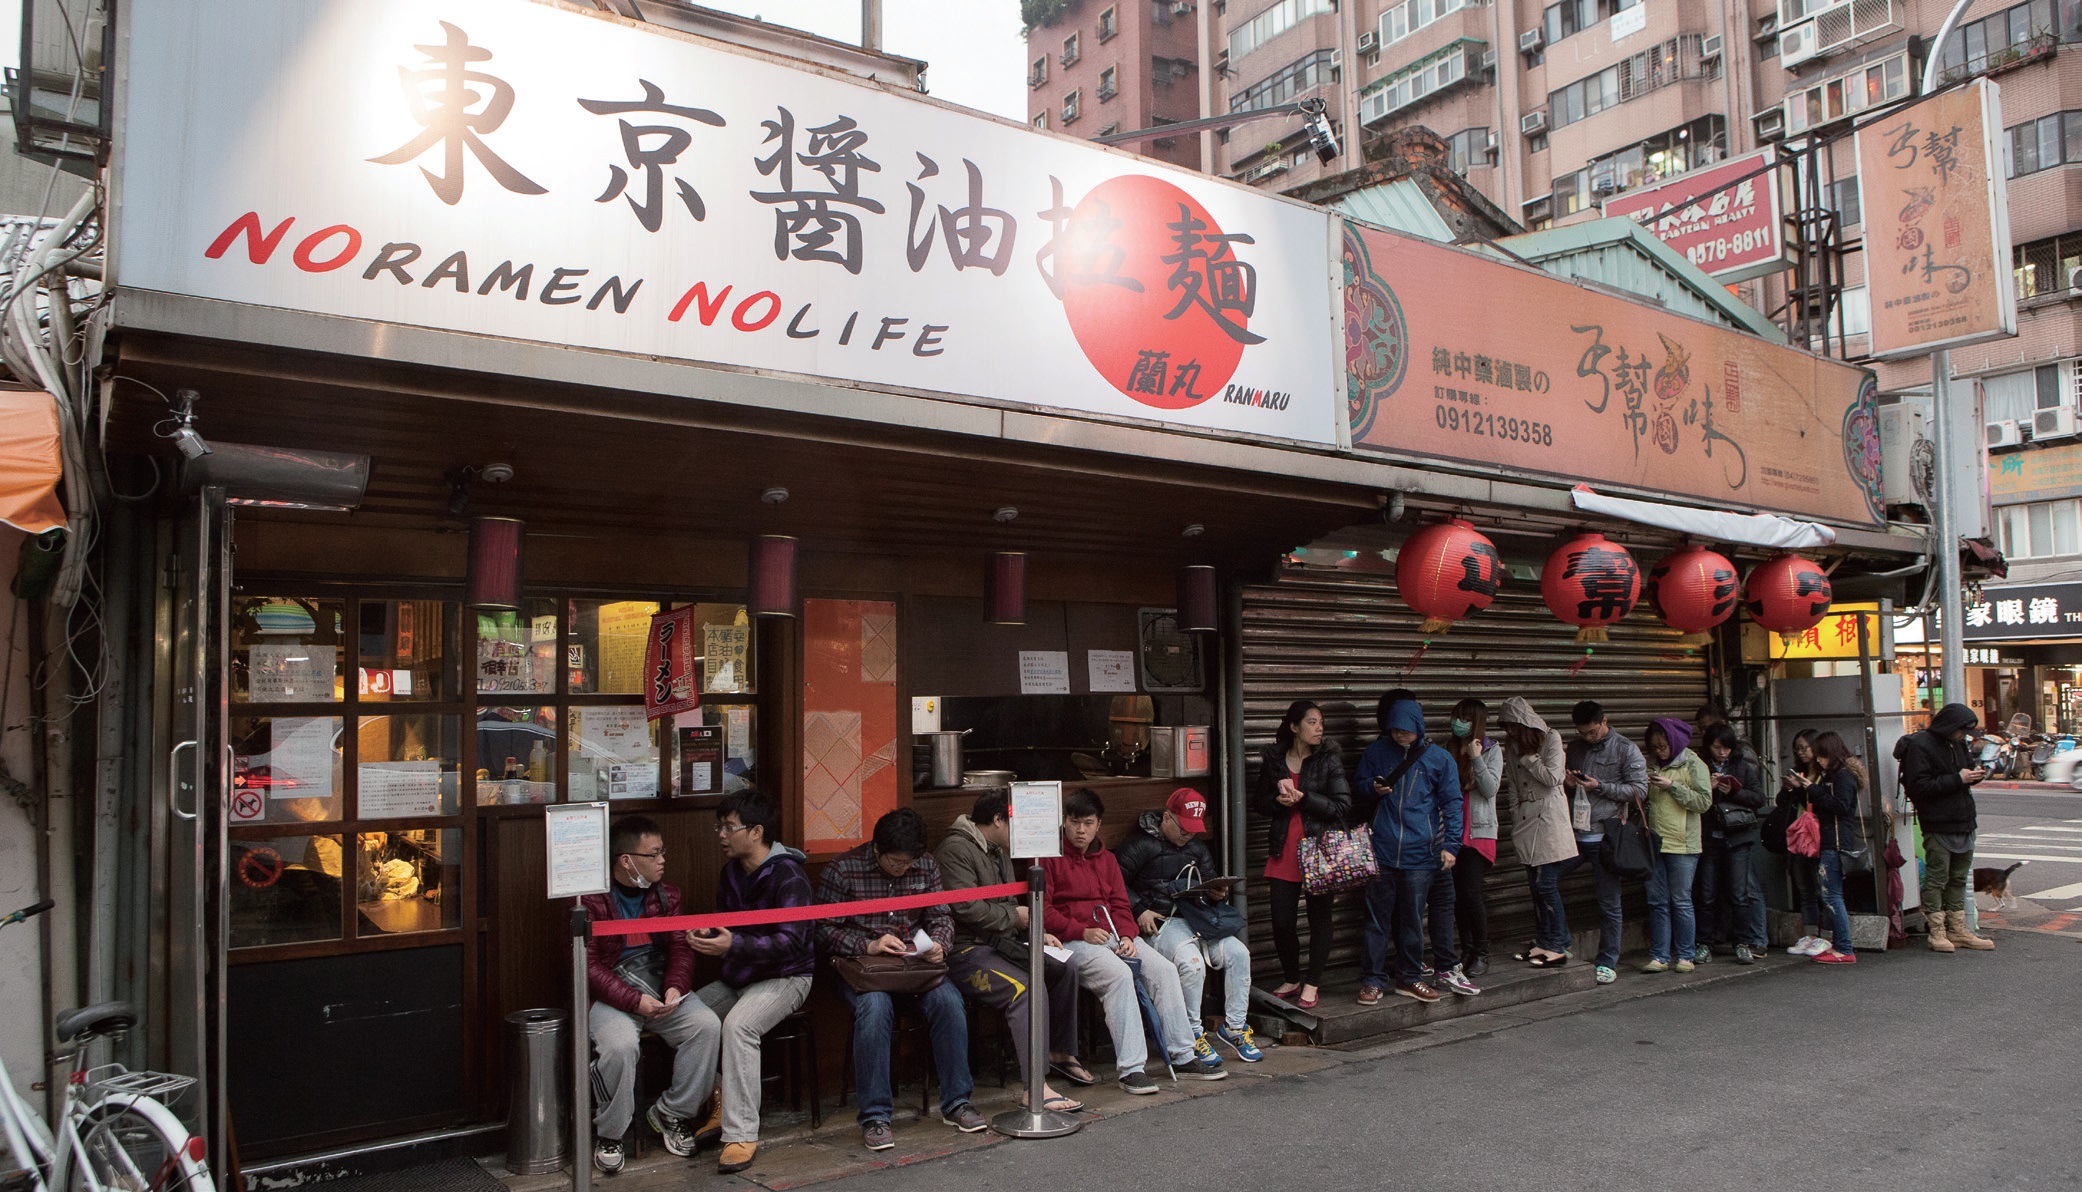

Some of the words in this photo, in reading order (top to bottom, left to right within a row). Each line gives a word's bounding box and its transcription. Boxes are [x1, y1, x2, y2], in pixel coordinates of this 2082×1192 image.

[204, 211, 362, 272] NO
[362, 242, 644, 314] RAMEN
[667, 281, 782, 333] NO
[786, 303, 949, 357] LIFE
[1126, 350, 1203, 399] 蘭丸
[1223, 384, 1291, 411] RANMARU
[1435, 404, 1553, 447] 0912139358
[655, 621, 676, 704] ラーメン
[1971, 700, 1984, 708] 83
[1193, 808, 1204, 818] 17
